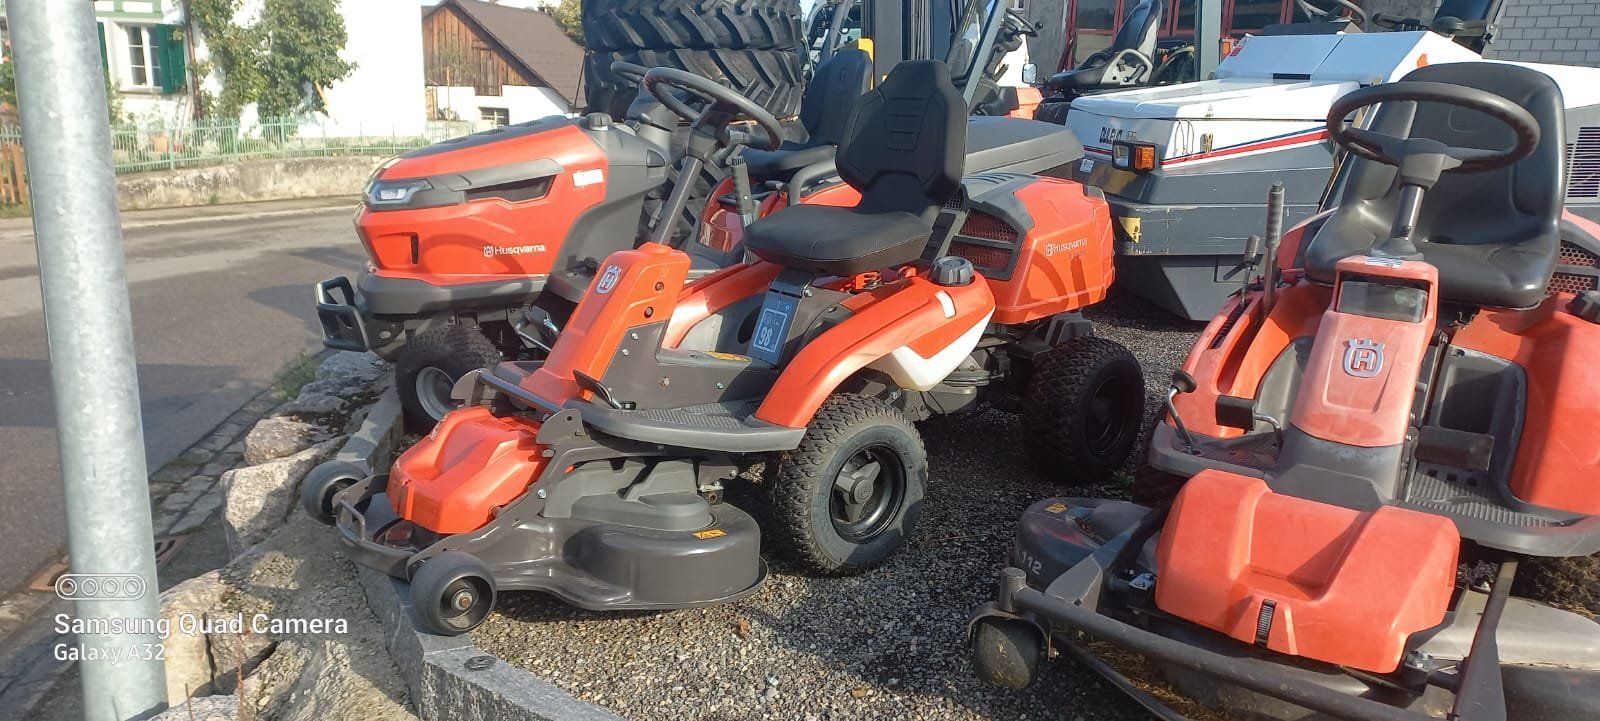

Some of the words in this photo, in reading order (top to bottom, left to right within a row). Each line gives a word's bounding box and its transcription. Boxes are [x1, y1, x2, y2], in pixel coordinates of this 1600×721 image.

[495, 244, 546, 256] Husqvarna
[1053, 238, 1088, 253] Husqvarna
[758, 326, 773, 346] 98
